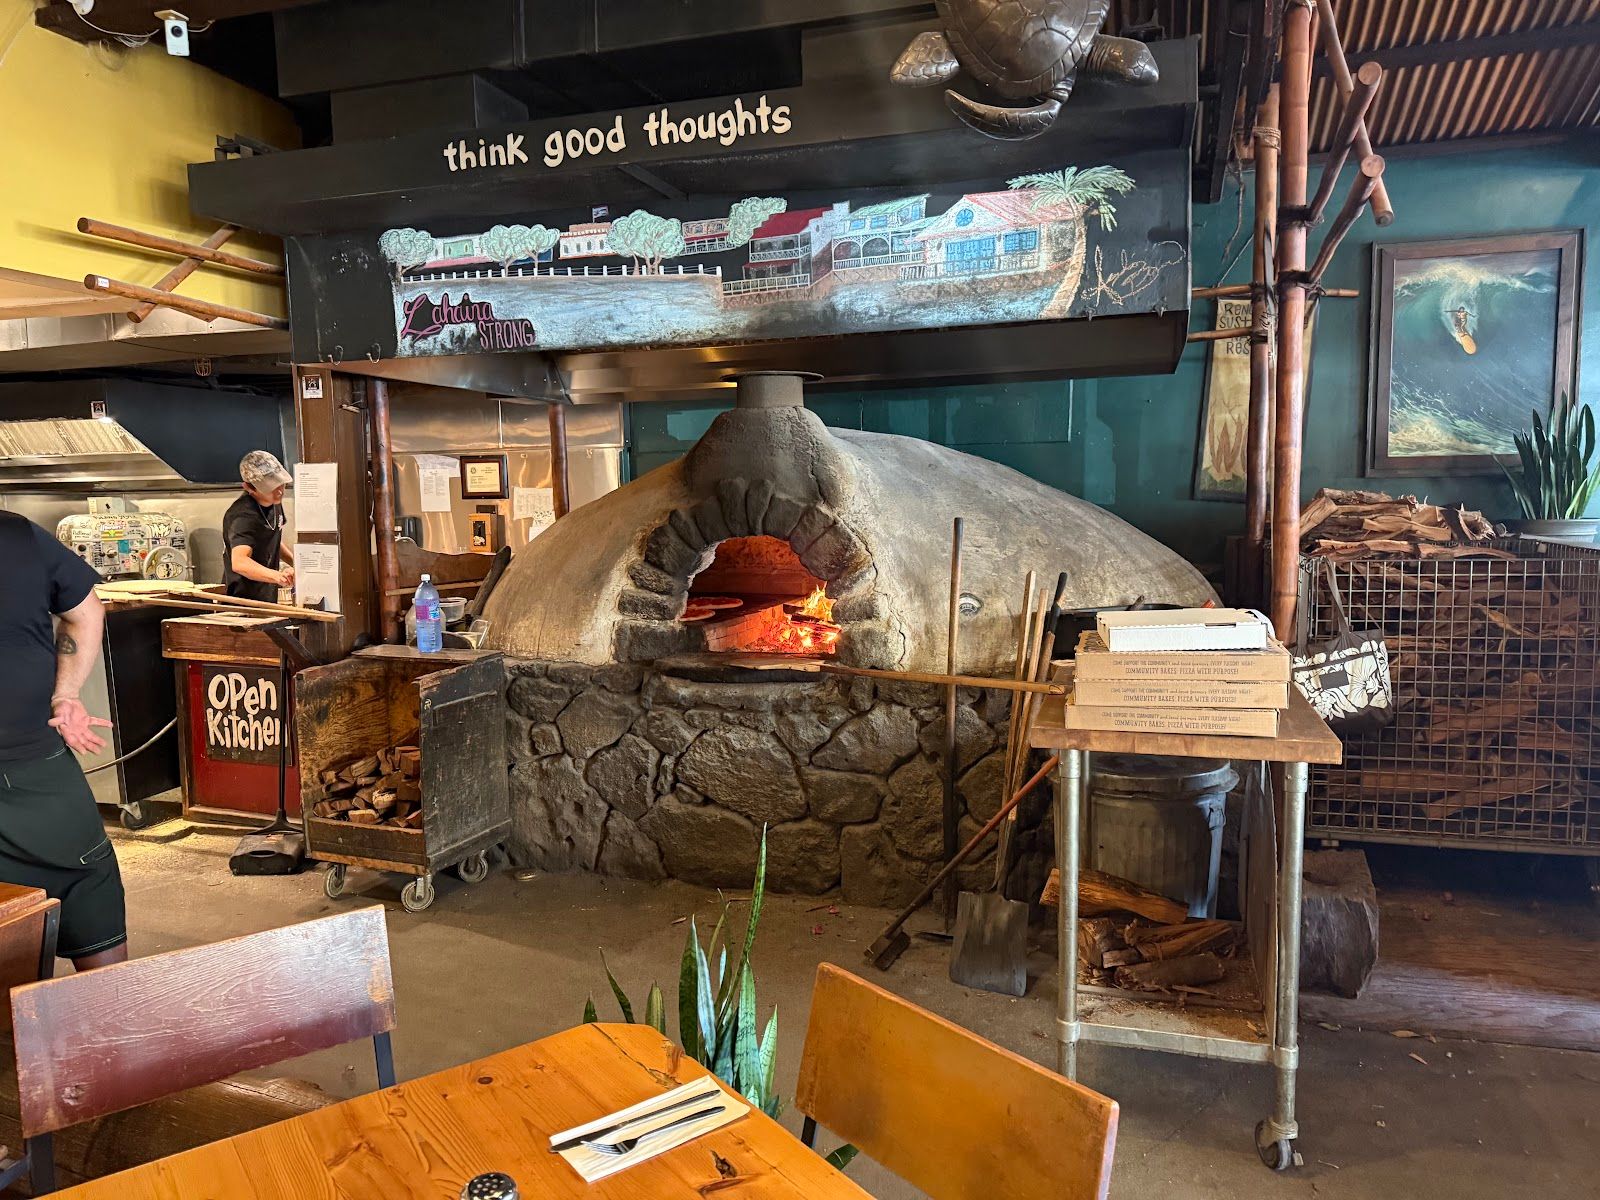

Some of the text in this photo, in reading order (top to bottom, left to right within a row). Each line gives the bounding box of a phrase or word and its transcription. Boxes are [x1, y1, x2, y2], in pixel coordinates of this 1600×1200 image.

[543, 115, 627, 168] good
[643, 95, 792, 146] thoughts
[400, 293, 495, 341] Lahaina
[479, 320, 536, 350] STRONG
[1115, 719, 1147, 727] COMMUNITY
